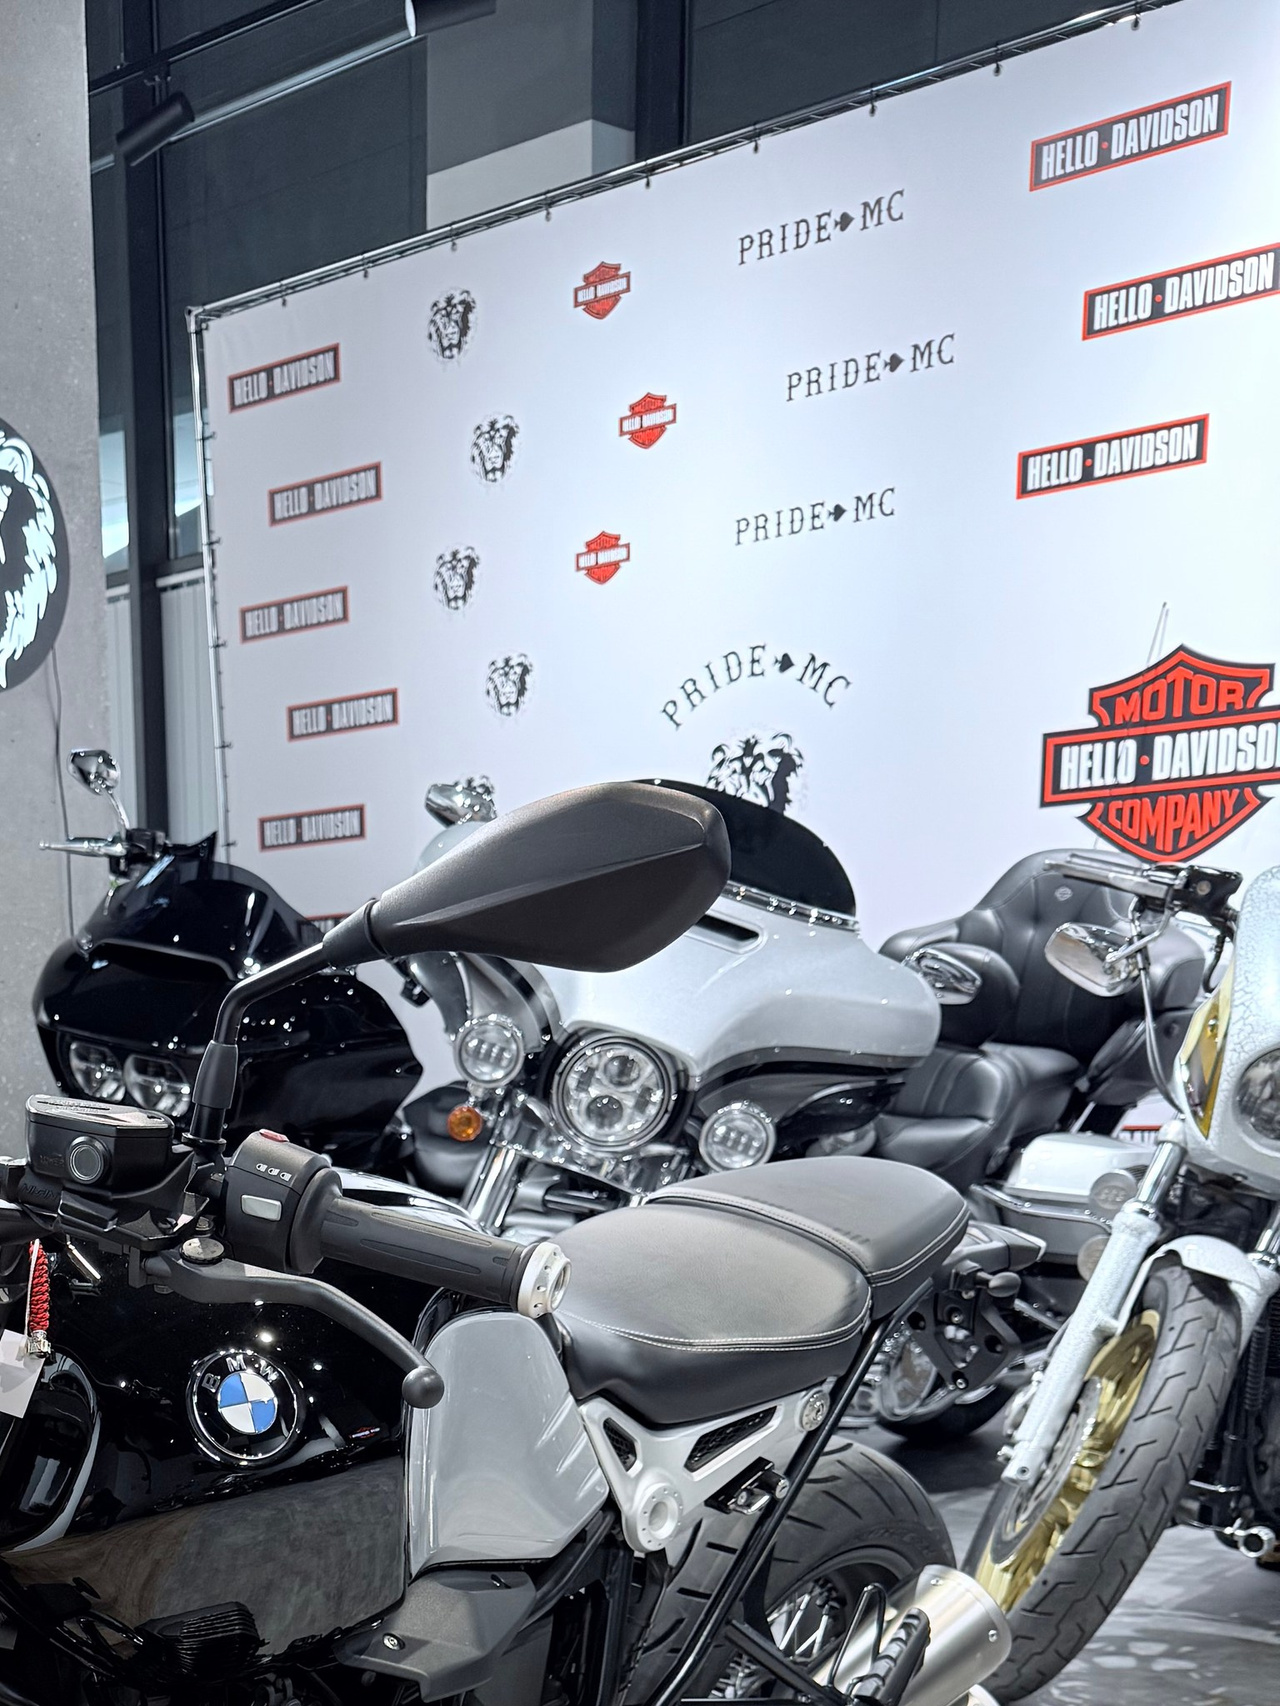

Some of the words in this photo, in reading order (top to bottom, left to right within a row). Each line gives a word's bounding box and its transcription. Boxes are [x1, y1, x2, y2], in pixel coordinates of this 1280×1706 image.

[1041, 130, 1099, 180] HELLO
[1110, 94, 1219, 160] DAVIDSON
[738, 209, 832, 265] PRIDE
[860, 188, 905, 231] MC
[1093, 283, 1153, 330] HELLO
[1164, 252, 1275, 313] DAVIDSON
[786, 350, 882, 402] PRIDE
[909, 332, 955, 372] MC
[1026, 447, 1083, 491] HELLO
[1093, 423, 1198, 477] DAVIDSON
[735, 501, 825, 546] PRIDE
[853, 486, 895, 523] MC
[660, 643, 767, 731] PRIDE
[796, 653, 853, 710] MC
[1115, 666, 1244, 725] MOTOR
[1060, 739, 1137, 790] HELLO
[1108, 788, 1240, 852] COMPANY
[201, 1354, 280, 1393] BMW
